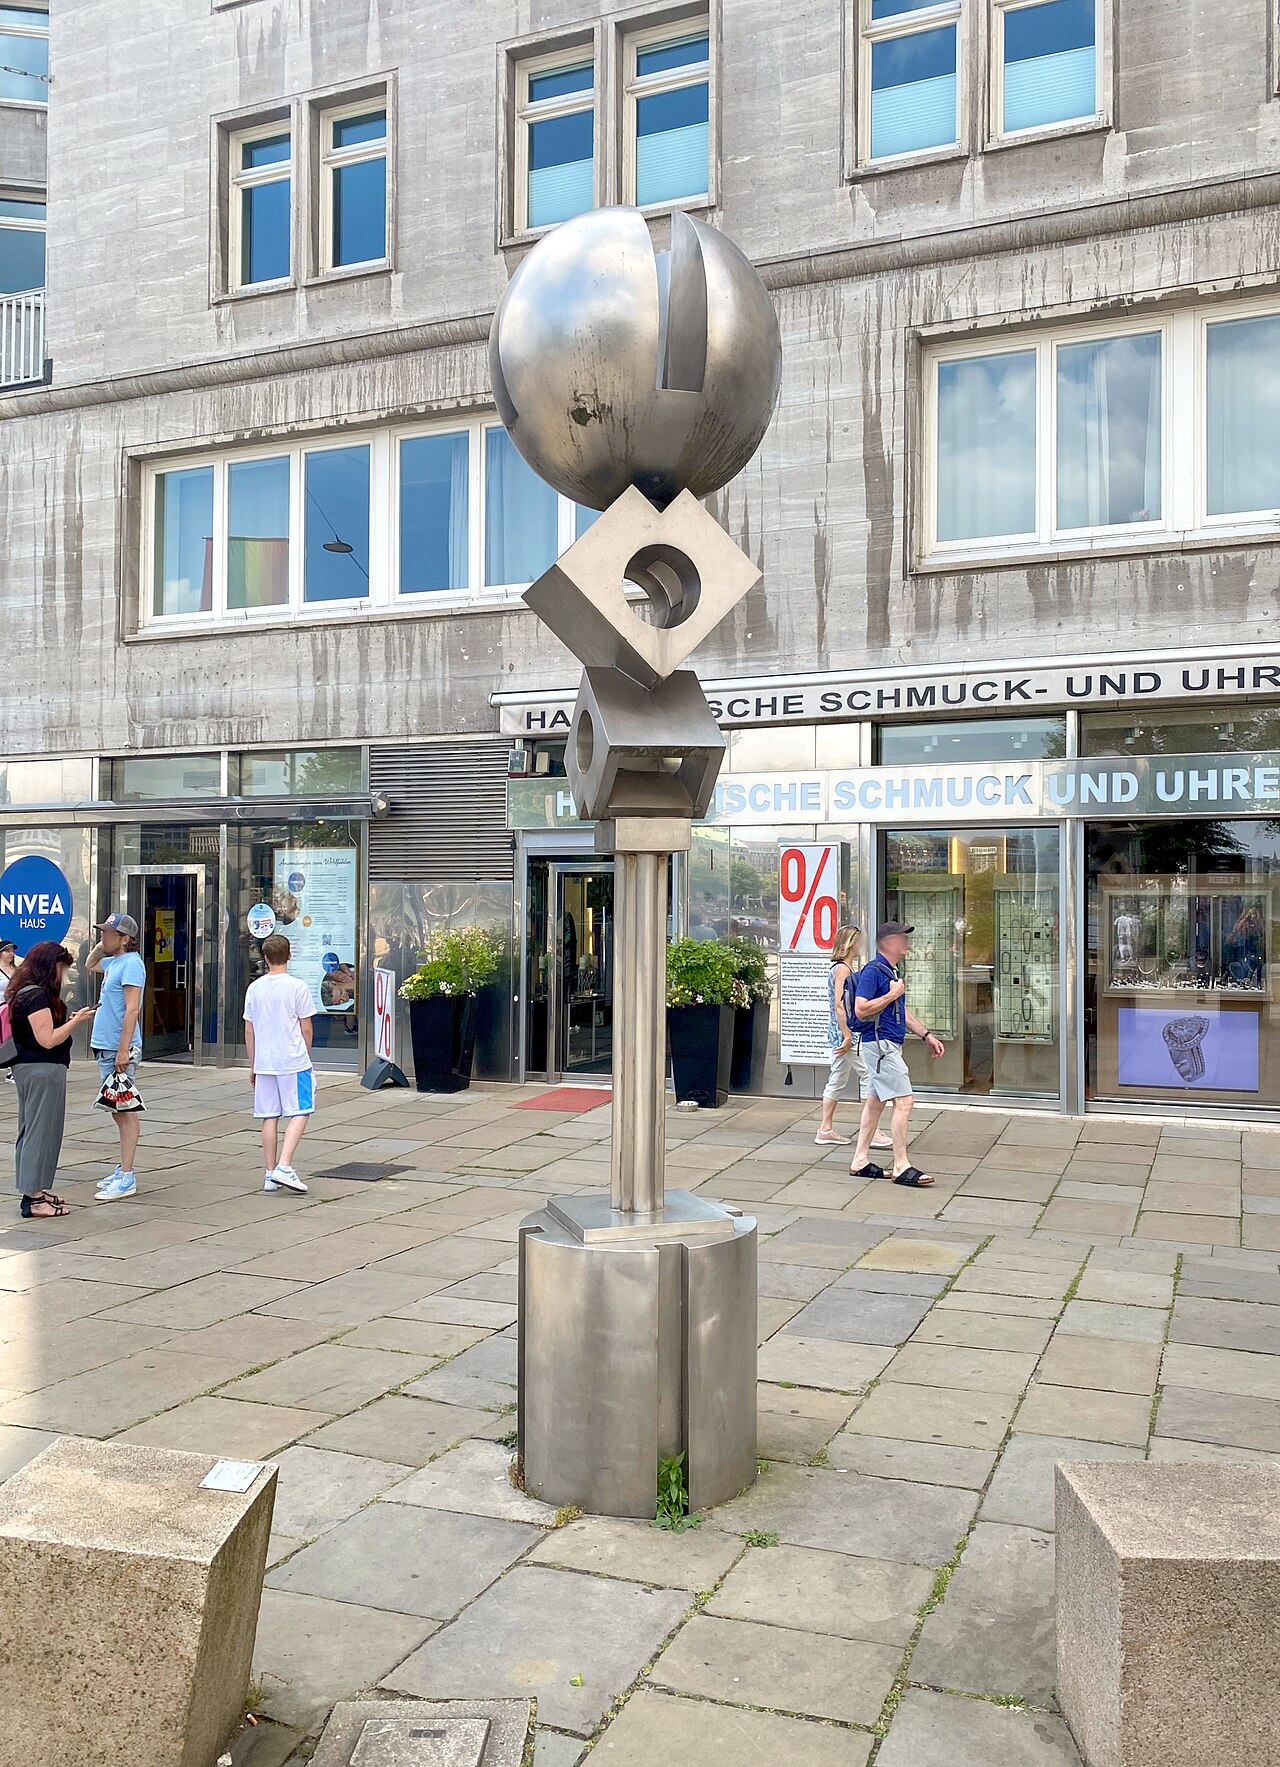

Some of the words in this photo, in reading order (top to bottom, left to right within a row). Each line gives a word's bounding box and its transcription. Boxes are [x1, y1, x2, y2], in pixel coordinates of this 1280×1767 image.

[819, 678, 1047, 713] SCHMUCK-
[1065, 672, 1162, 697] UND
[834, 773, 1033, 810] SCHMUCK
[1048, 771, 1140, 806] UND
[0, 893, 65, 916] NIVEA
[19, 918, 46, 929] HAUS
